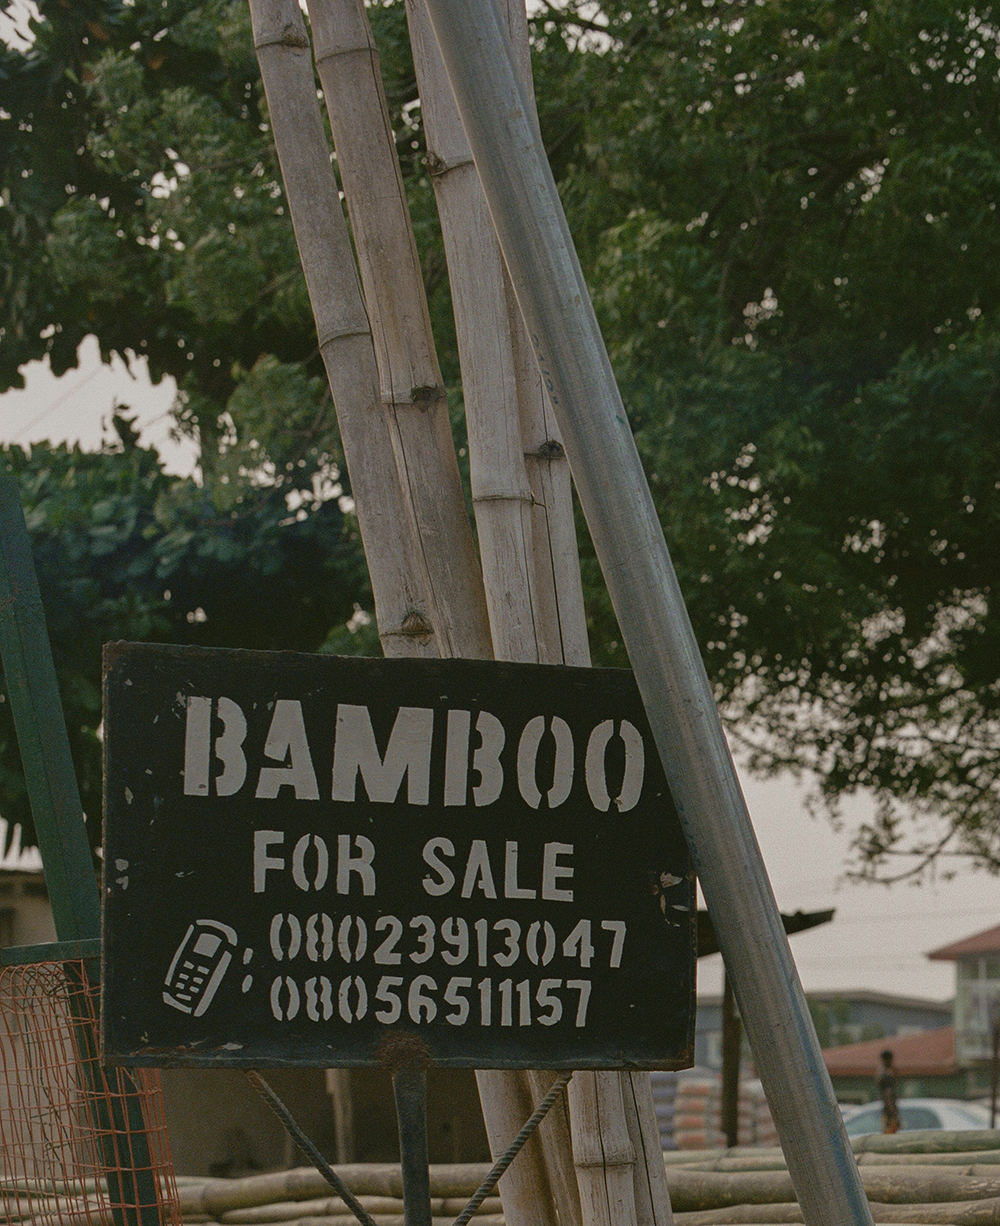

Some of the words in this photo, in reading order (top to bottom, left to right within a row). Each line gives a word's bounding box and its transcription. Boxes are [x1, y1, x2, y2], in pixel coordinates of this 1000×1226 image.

[184, 695, 645, 812] BAMBOO
[254, 829, 376, 897] FOR
[422, 836, 575, 904] SALE
[270, 913, 627, 969] 08023913047
[270, 975, 592, 1028] 08056511157
